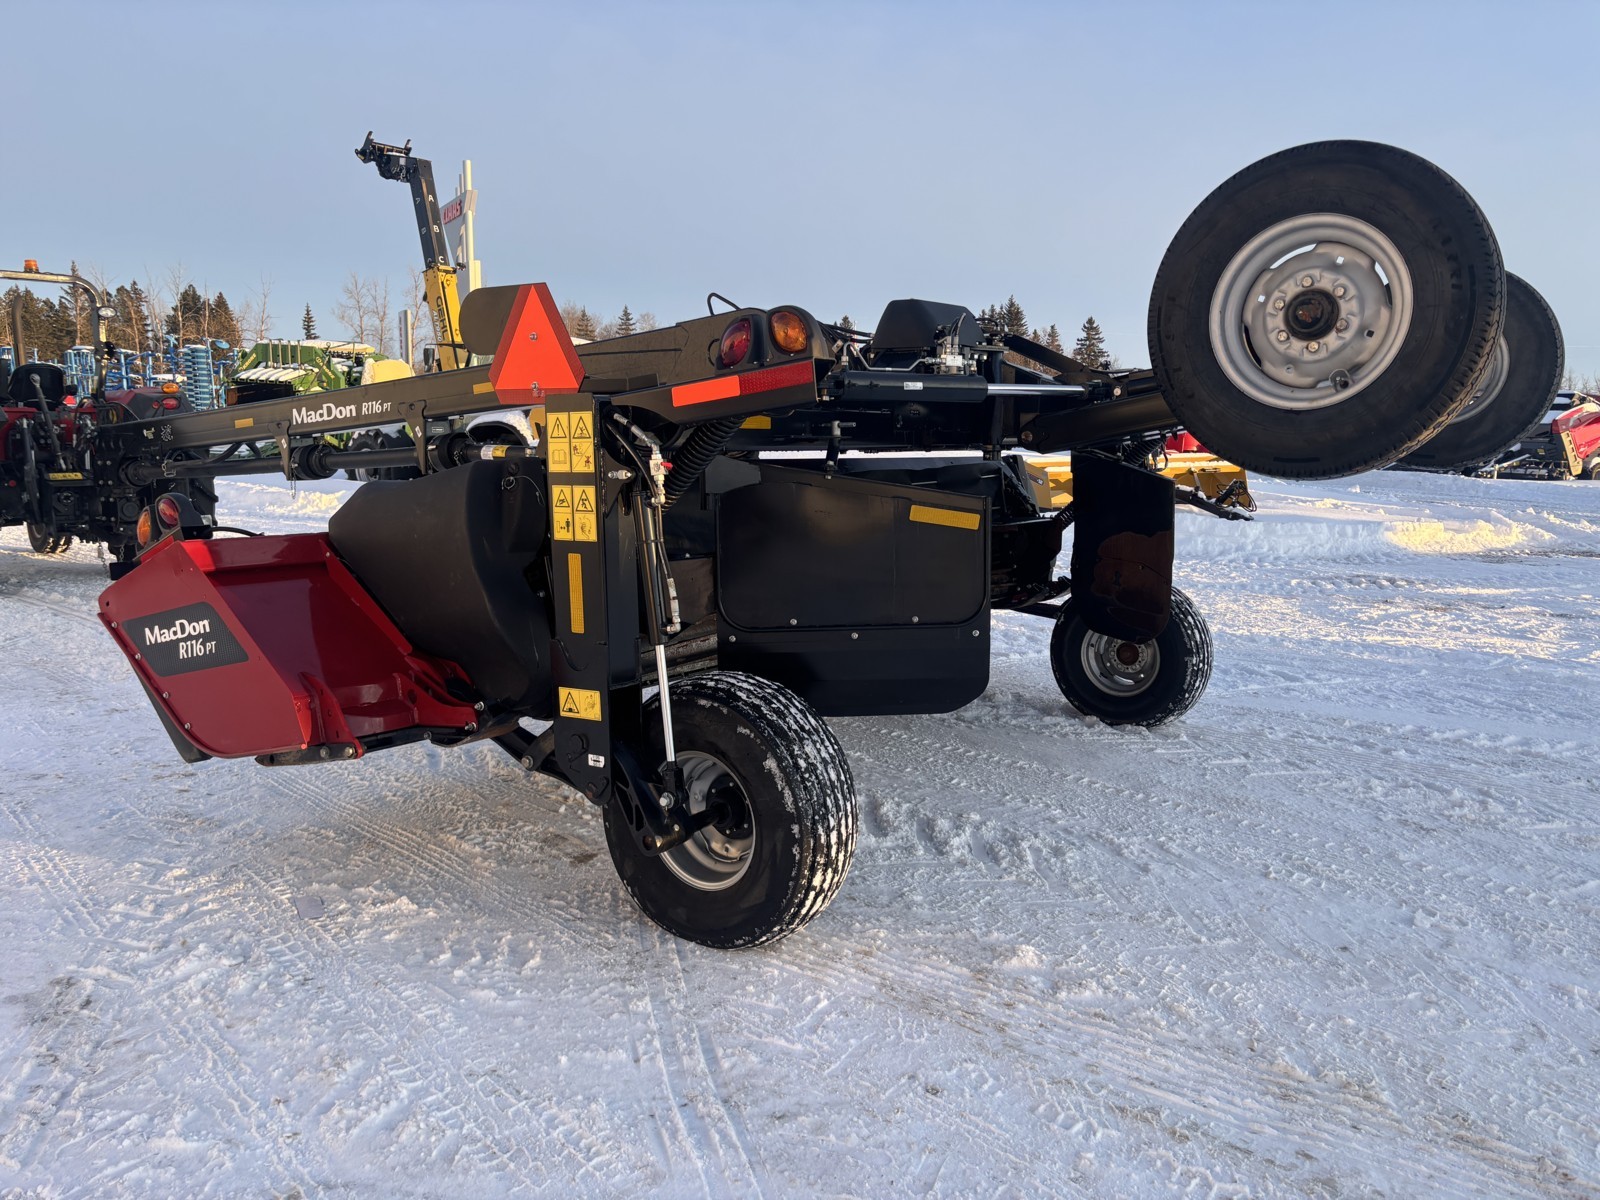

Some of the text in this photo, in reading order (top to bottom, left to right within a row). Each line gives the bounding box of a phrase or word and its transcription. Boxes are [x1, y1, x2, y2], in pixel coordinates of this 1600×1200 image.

[436, 295, 448, 341] GEHL
[292, 400, 392, 425] MacDon R116 PT
[144, 619, 211, 646] MacDon
[179, 638, 217, 660] R116 PT
